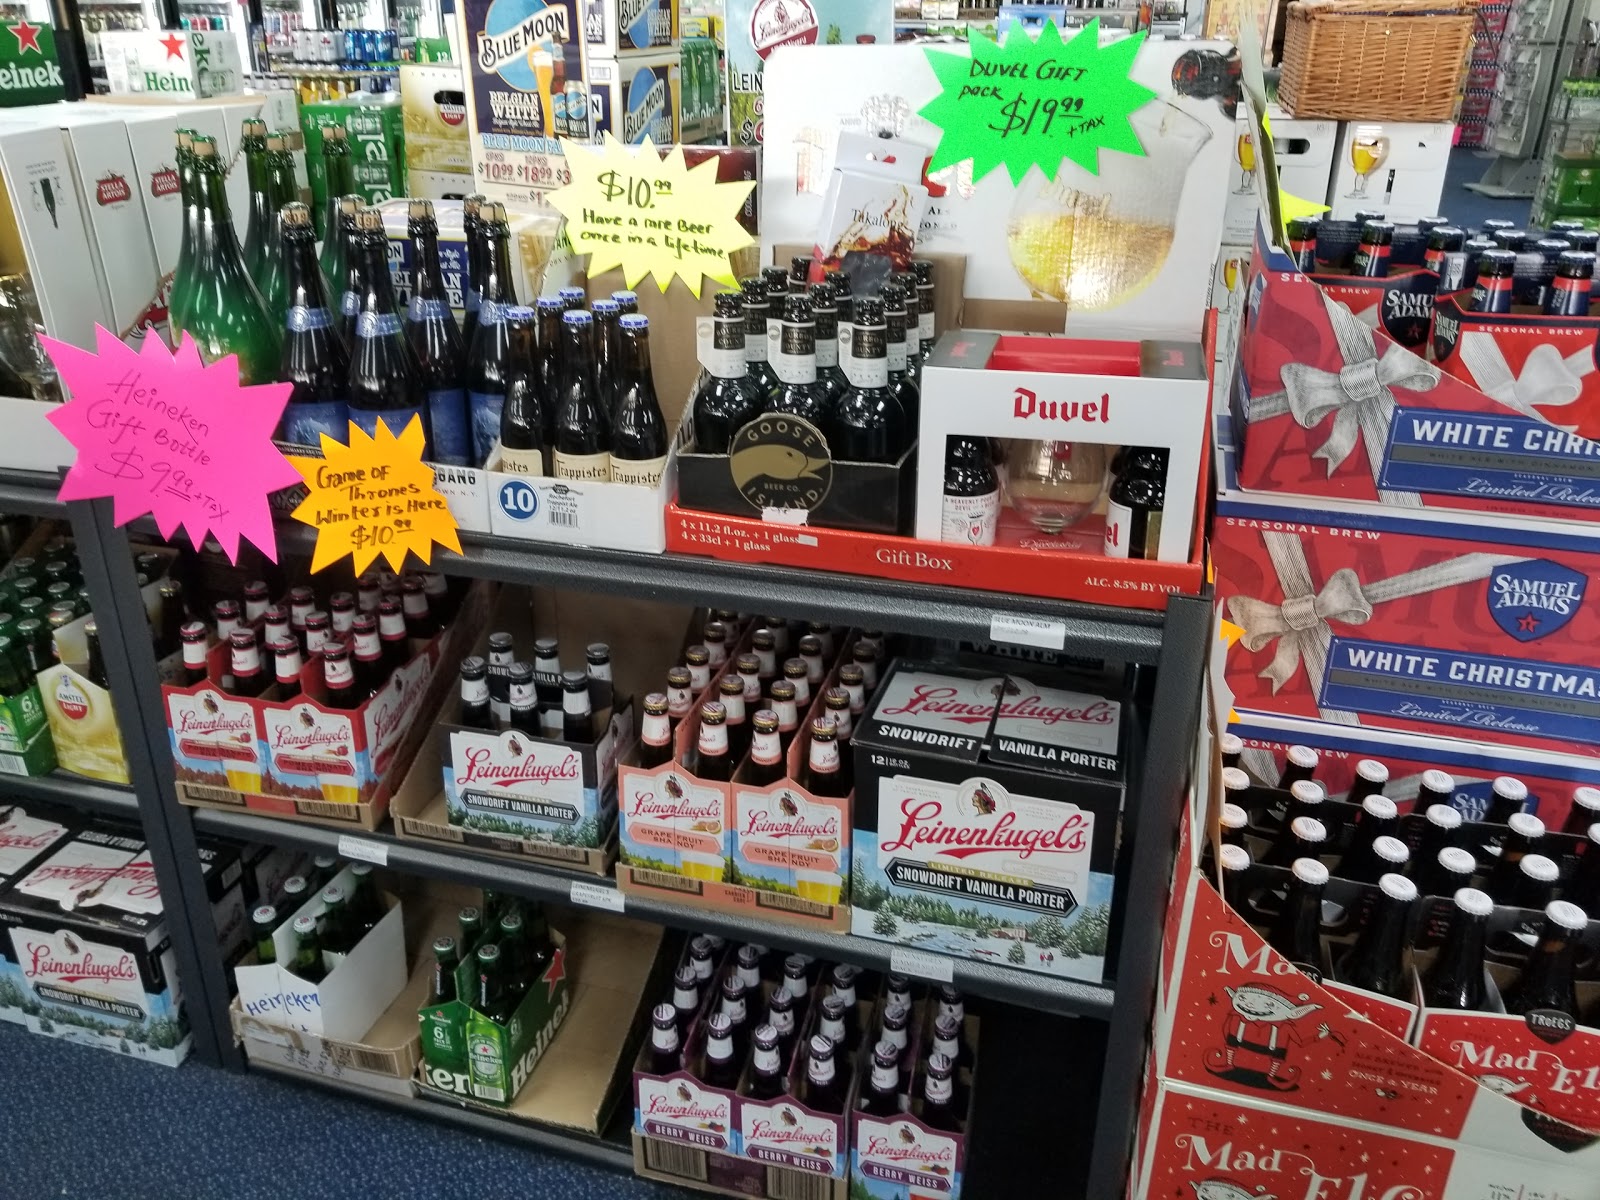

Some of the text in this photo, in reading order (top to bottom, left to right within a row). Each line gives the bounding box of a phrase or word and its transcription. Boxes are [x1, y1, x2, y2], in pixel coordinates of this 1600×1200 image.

[482, 33, 521, 68] BLUE
[522, 12, 565, 46] MOON
[0, 60, 64, 90] einek
[144, 72, 191, 92] Hein
[733, 73, 763, 91] LEIN
[970, 58, 1088, 81] DUVEL GIFT
[490, 91, 539, 106] BELGIAN
[491, 101, 540, 120] WHITE
[625, 82, 664, 144] BLUE MOON
[511, 136, 545, 153] MOON
[101, 181, 124, 192] STELLA
[103, 188, 126, 200] ARTOIS
[583, 208, 622, 227] Have
[628, 217, 638, 227] a
[677, 219, 713, 235] Beer
[580, 231, 658, 247] once in a
[1386, 290, 1434, 308] SAMU
[1388, 304, 1433, 320] ADAM
[1478, 325, 1583, 337] SEASONAL BREW
[108, 367, 209, 442] Heineken
[1014, 387, 1110, 424] Duvel
[87, 398, 212, 466] Gift Bottle
[747, 421, 816, 447] GOOSE
[1412, 419, 1513, 448] WHITE
[316, 465, 367, 490] Game
[764, 483, 784, 491] BEER
[340, 483, 421, 502] Thrones
[503, 487, 533, 514] 10
[316, 500, 447, 526] Winter is Here
[681, 519, 688, 529] 4
[764, 532, 770, 540] 1
[773, 533, 799, 544] glass
[682, 531, 688, 539] 4
[700, 534, 722, 546] 33cl
[735, 539, 740, 548] 1
[744, 541, 771, 552] glass
[1226, 518, 1381, 540] SEASONAL BREW
[876, 548, 953, 571] Gift Box
[1085, 576, 1111, 588] ALC.
[1141, 582, 1157, 593] BY
[1493, 574, 1581, 601] SAMUEL
[1494, 592, 1571, 616] ADAMS
[1347, 647, 1440, 677] WHITE
[59, 692, 84, 703] AMSTEL
[62, 702, 83, 713] LIGHT
[1391, 701, 1470, 722] Limited
[879, 724, 1118, 773] SNOWDRIFT VANILLA PORTER
[457, 747, 579, 788] Leinenkugel's
[467, 794, 575, 820] SNOWDRIFT VANILLA PORTER
[628, 791, 721, 820] Leinenkugel's
[740, 809, 839, 839] Leinenkugel's
[880, 798, 1087, 859] Leinenkugel's
[930, 863, 975, 876] LIMITED
[896, 865, 1066, 911] SNOWDRIFT VANILLA PORTER
[25, 943, 137, 984] Leinenkugel's
[1210, 931, 1299, 977] Ma
[40, 988, 80, 1004] SNOWDRIFT
[80, 995, 111, 1012] VANILLA
[112, 1002, 140, 1018] PORTER
[247, 992, 321, 1017] Heineken
[433, 1026, 443, 1039] 6
[1450, 1040, 1562, 1071] Mad
[1549, 1062, 1600, 1094] El
[655, 1124, 716, 1147] BERRY WEISS
[757, 1149, 822, 1171] BERRY WEISS
[1174, 1133, 1314, 1172] Mad
[872, 1166, 938, 1189] BERRY WEISS
